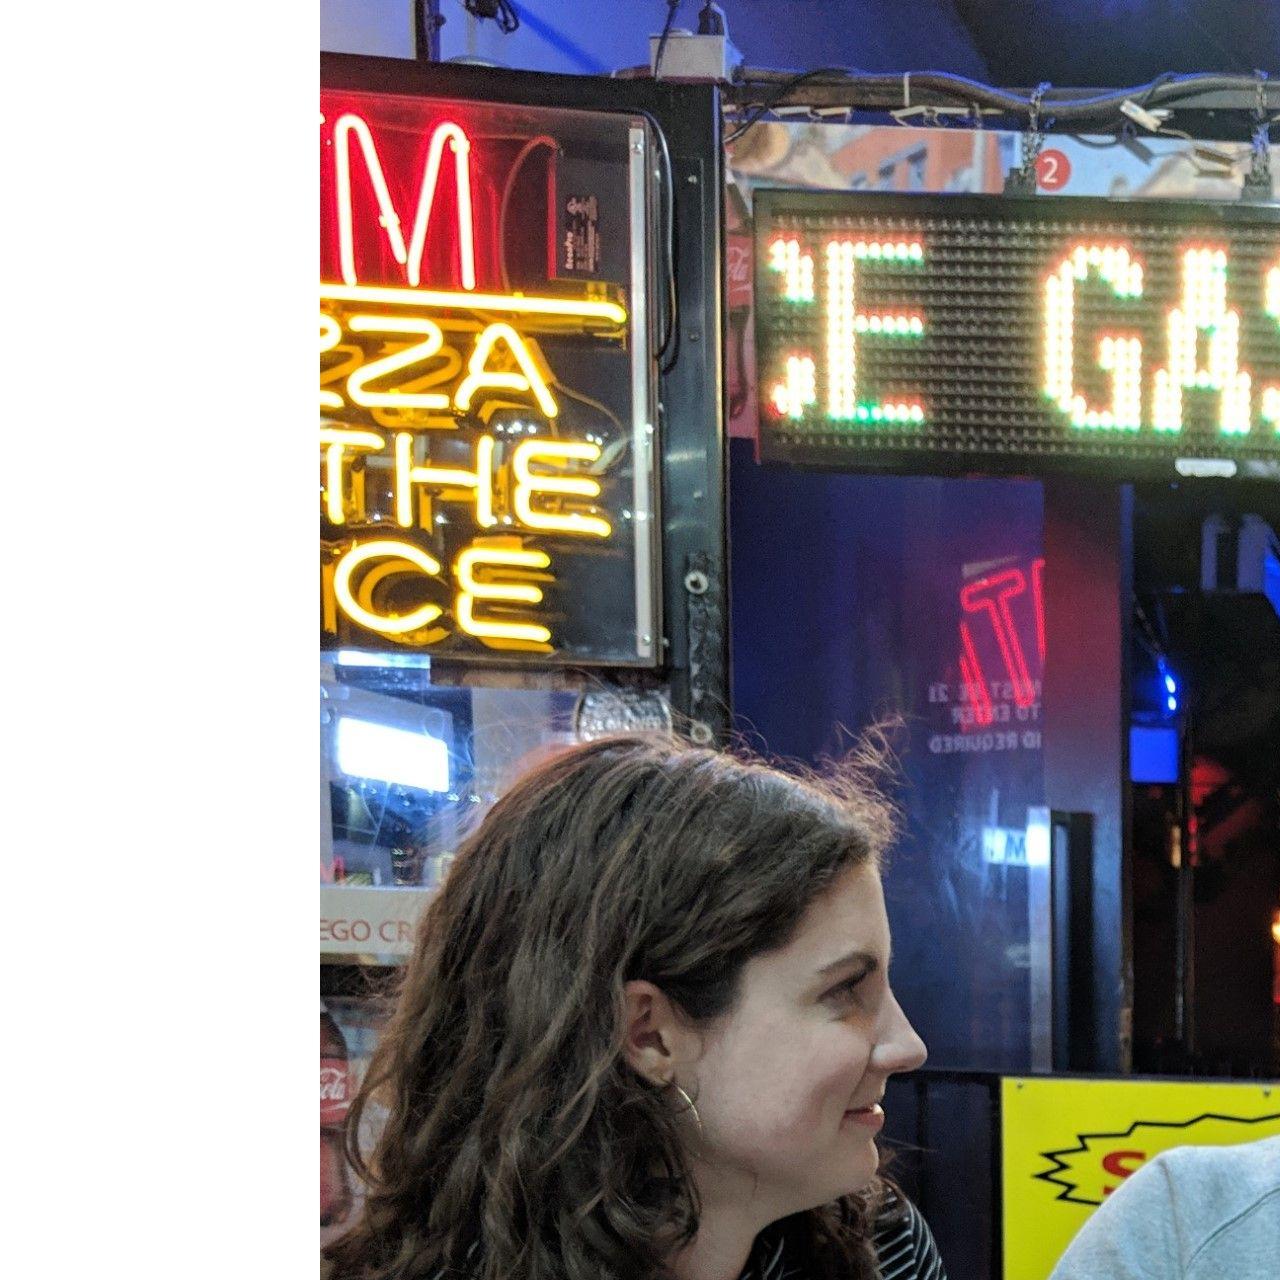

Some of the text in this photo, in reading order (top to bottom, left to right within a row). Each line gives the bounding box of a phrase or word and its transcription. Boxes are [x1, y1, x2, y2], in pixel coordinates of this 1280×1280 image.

[1041, 156, 1060, 184] 2
[320, 312, 559, 419] ZA
[320, 428, 612, 537] THE
